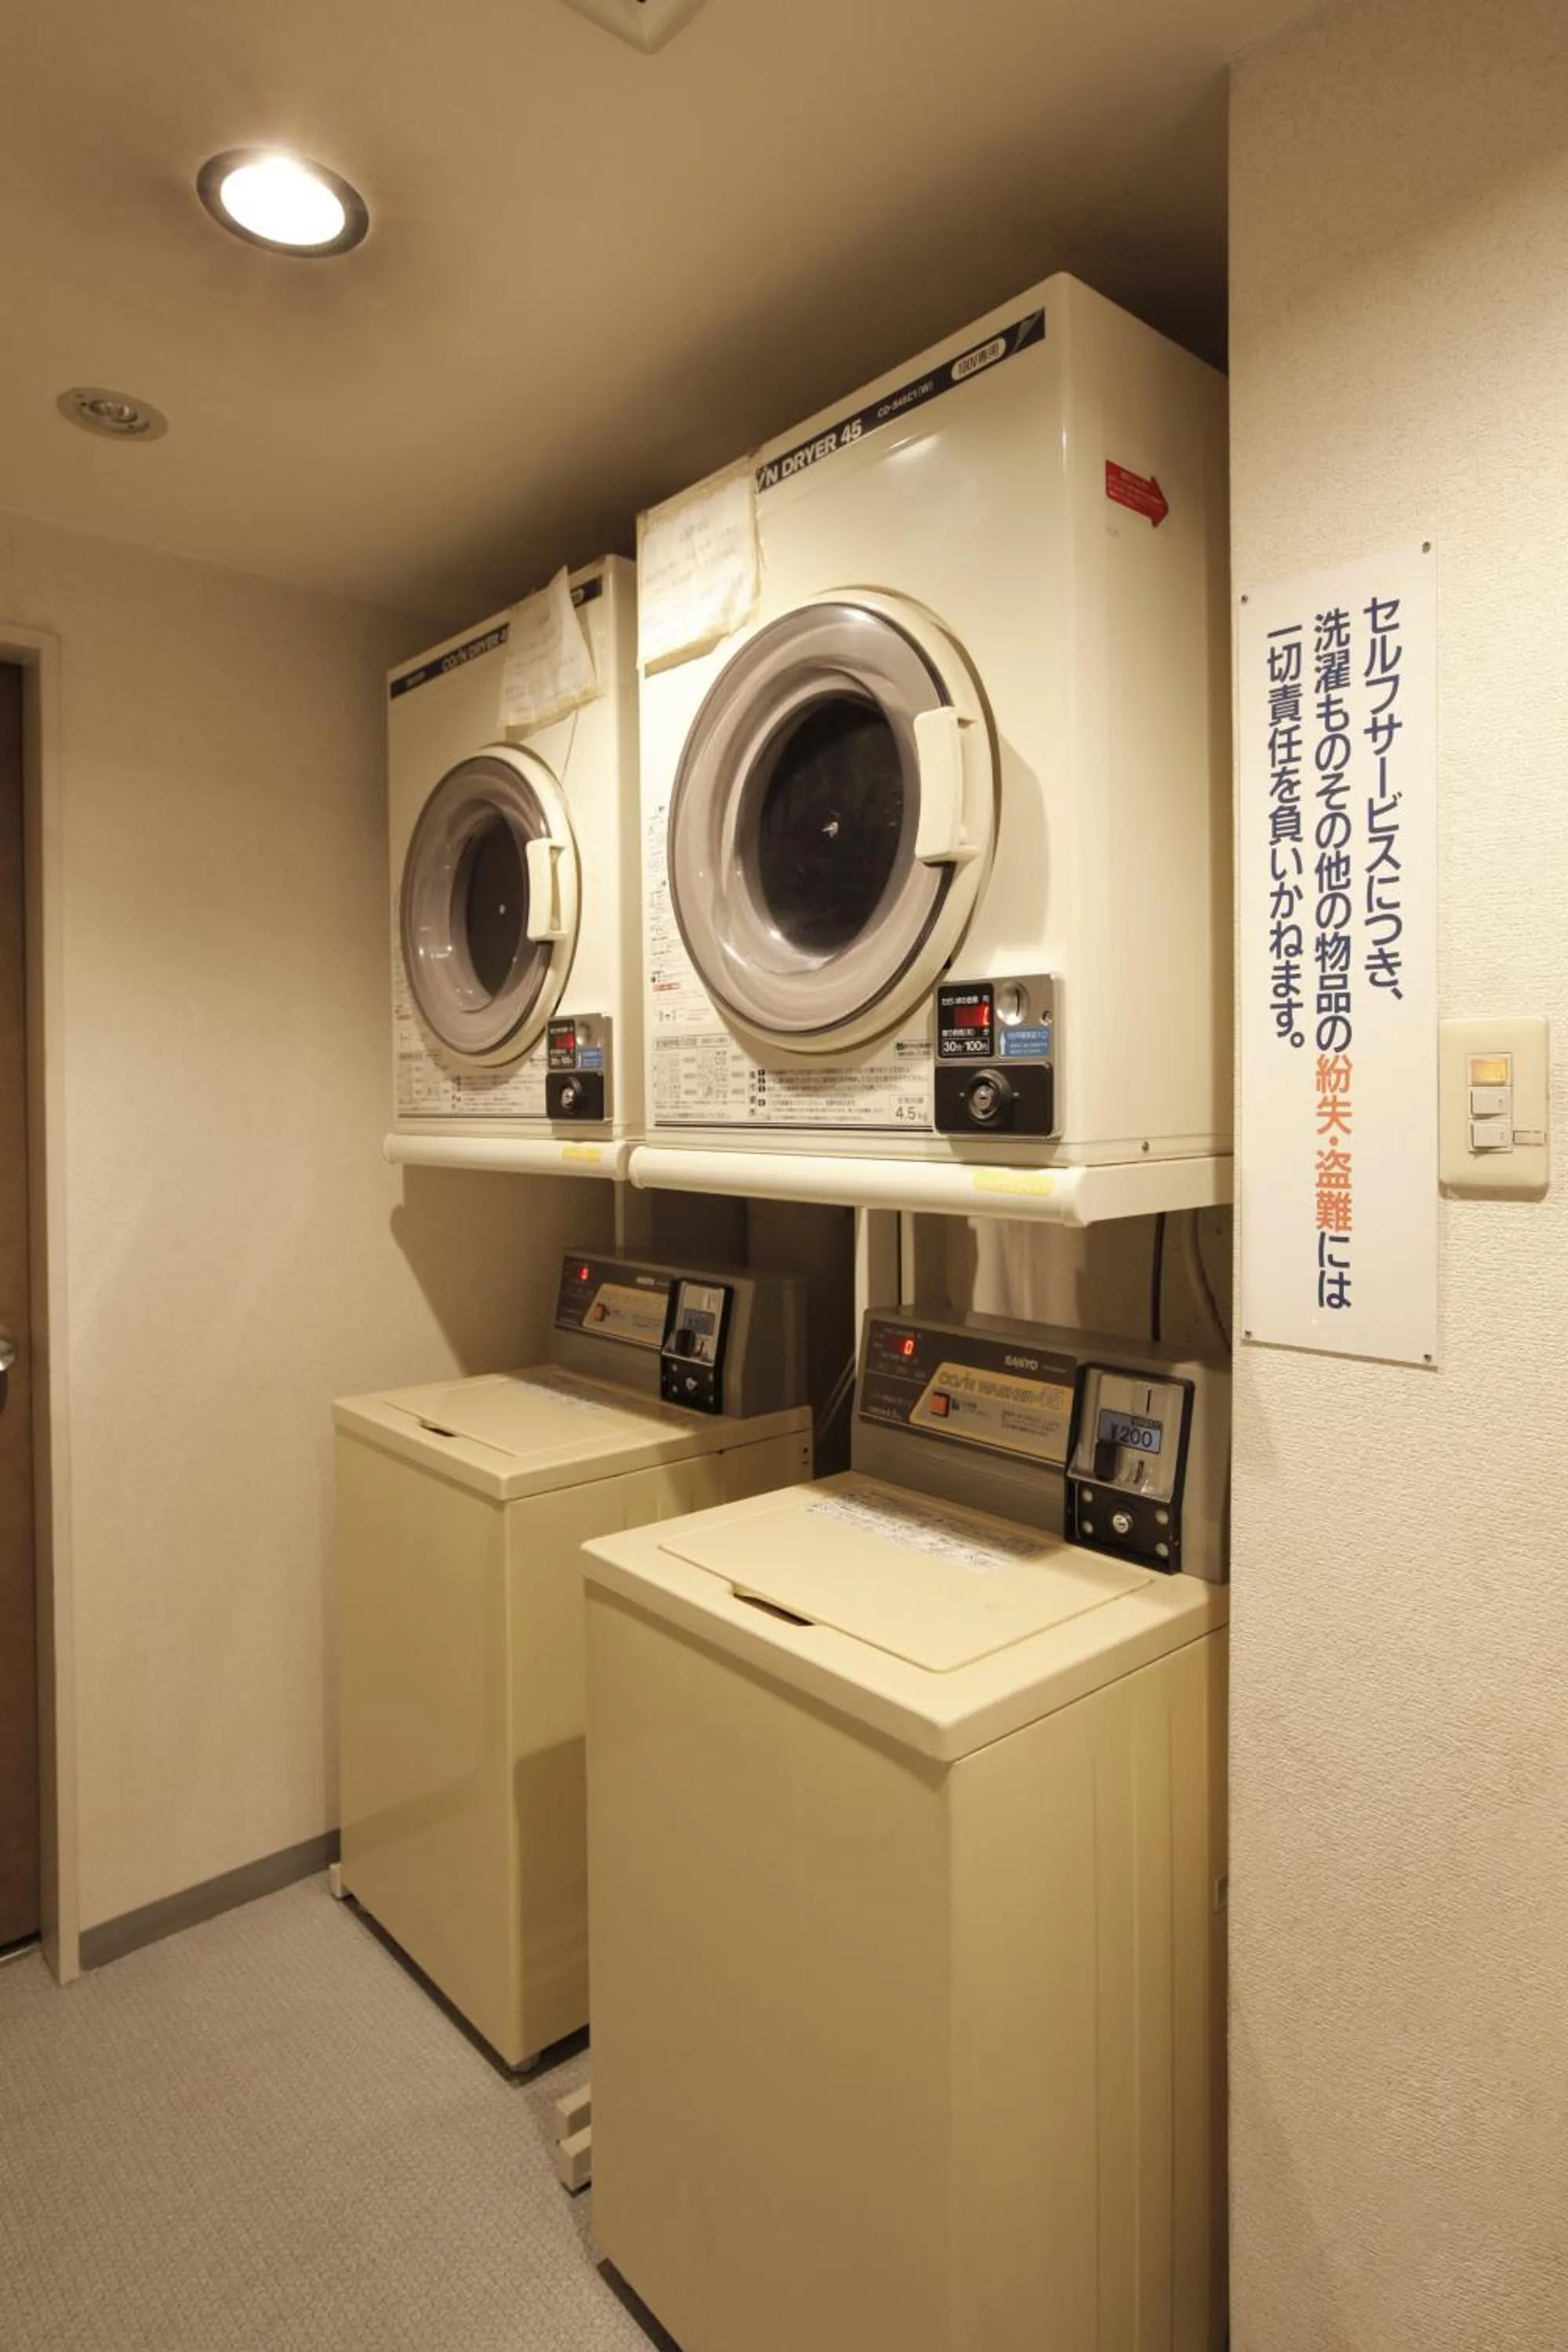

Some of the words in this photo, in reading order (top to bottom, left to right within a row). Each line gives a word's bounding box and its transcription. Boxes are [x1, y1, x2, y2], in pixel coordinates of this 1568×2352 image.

[782, 434, 837, 477] DRYER
[840, 418, 862, 445] 45
[1267, 625, 1305, 1048] 一切責任を負いかねます。
[1315, 608, 1352, 1309] 洗濯ものその他の物品の紛失・盗難には
[1363, 597, 1403, 1000] セルフサービスにつき、
[1004, 1355, 1038, 1370] SANYO
